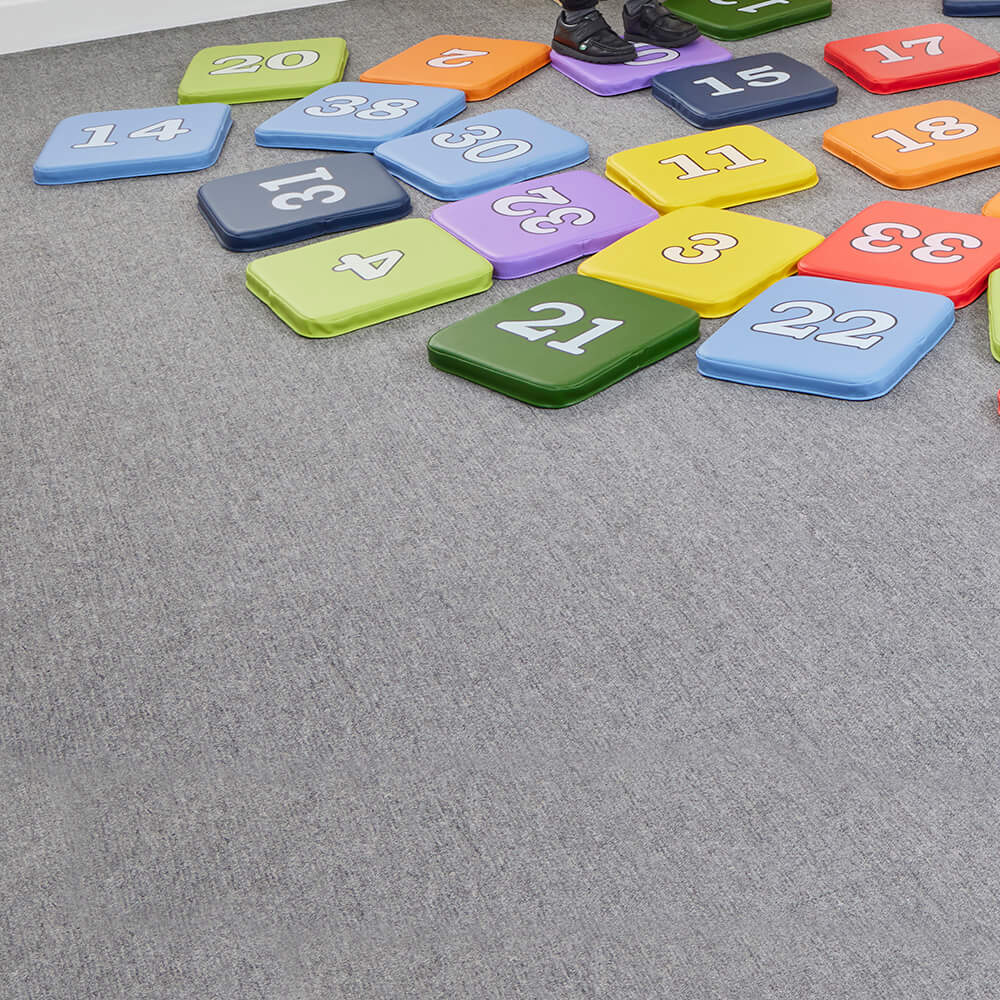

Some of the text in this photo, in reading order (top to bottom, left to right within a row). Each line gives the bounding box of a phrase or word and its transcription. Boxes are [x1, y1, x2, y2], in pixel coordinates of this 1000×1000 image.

[209, 49, 320, 76] 20
[426, 47, 490, 69] 2
[863, 34, 944, 65] 17
[692, 63, 792, 98] 15
[304, 94, 419, 121] 38
[70, 117, 191, 150] 14
[431, 123, 532, 164] 30
[872, 115, 979, 154] 18
[659, 144, 766, 181] 11
[257, 165, 347, 212] 31
[492, 185, 595, 234] 32
[662, 232, 738, 265] 3
[850, 221, 982, 265] 33
[332, 249, 404, 282] 4
[495, 301, 625, 356] 21
[750, 299, 898, 350] 22
